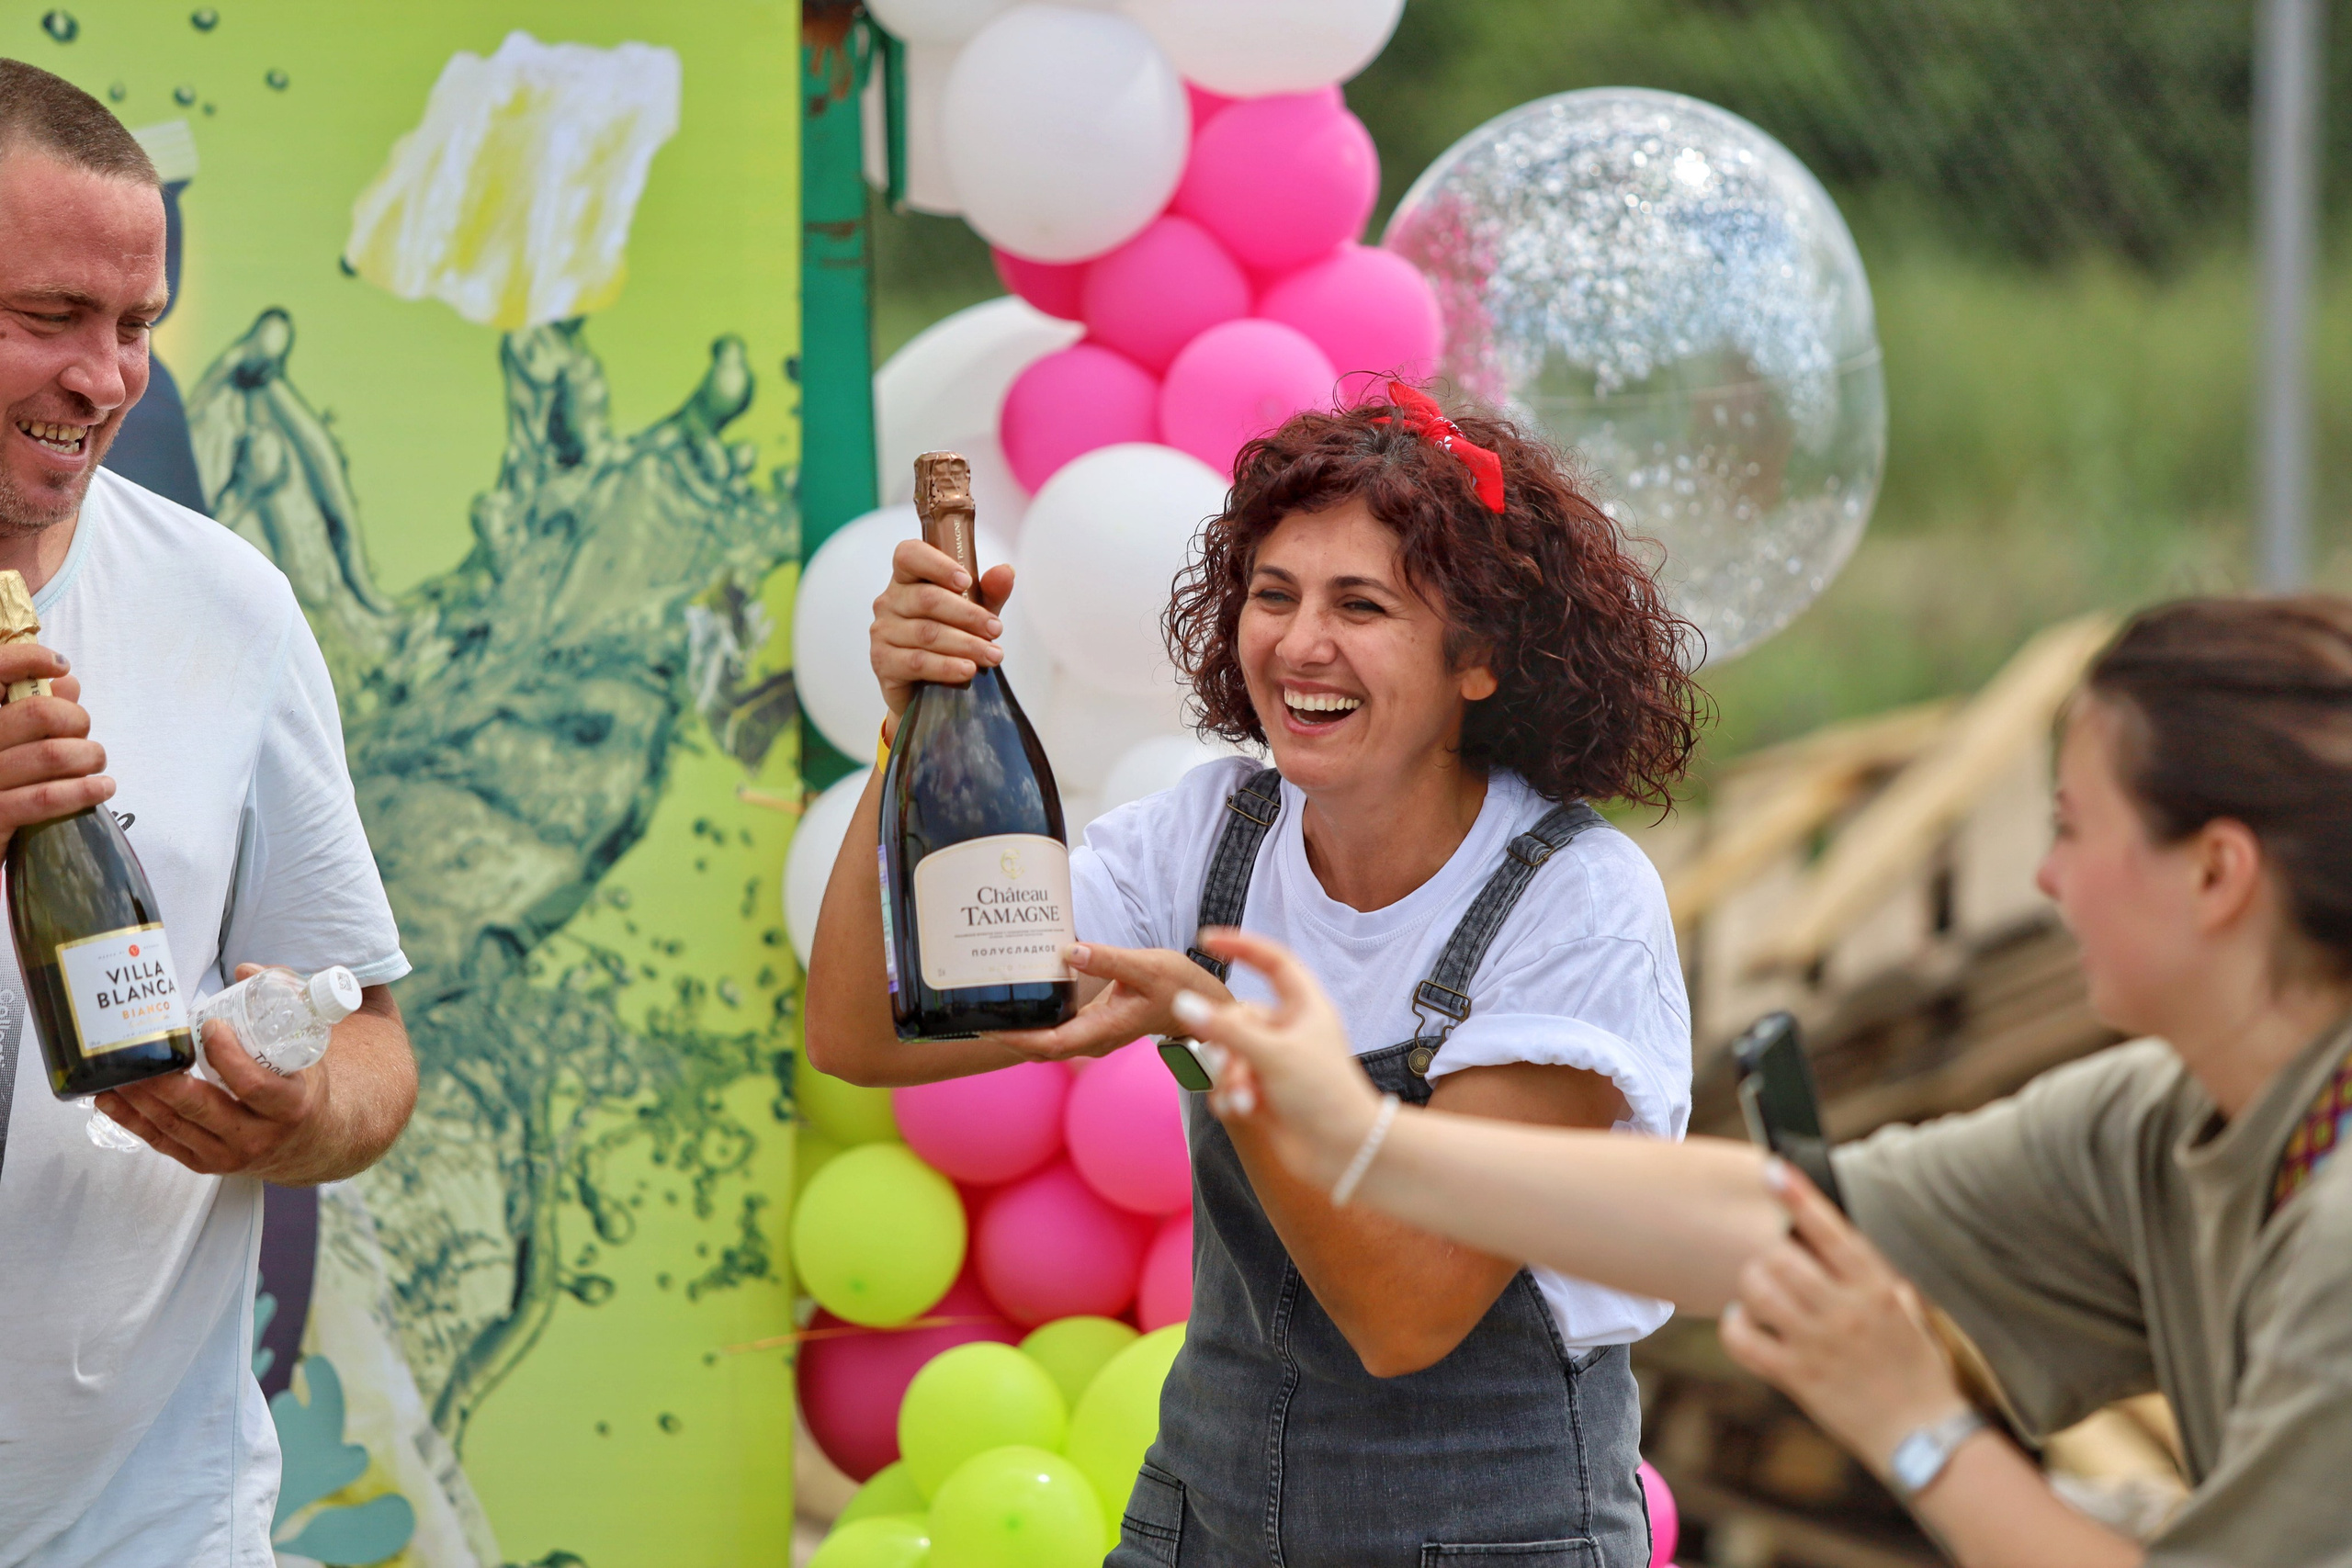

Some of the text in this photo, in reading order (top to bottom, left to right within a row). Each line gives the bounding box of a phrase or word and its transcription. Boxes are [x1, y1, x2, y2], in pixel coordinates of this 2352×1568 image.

[954, 519, 964, 559] TAMAGNE
[977, 886, 1048, 906] Château
[960, 905, 1060, 927] TAMAGNE
[971, 944, 1057, 958] ПОЛУСЛАДКОЕ
[106, 960, 165, 985] VILLA
[96, 977, 176, 1010] BLANCA
[122, 1000, 171, 1020] BIANCO
